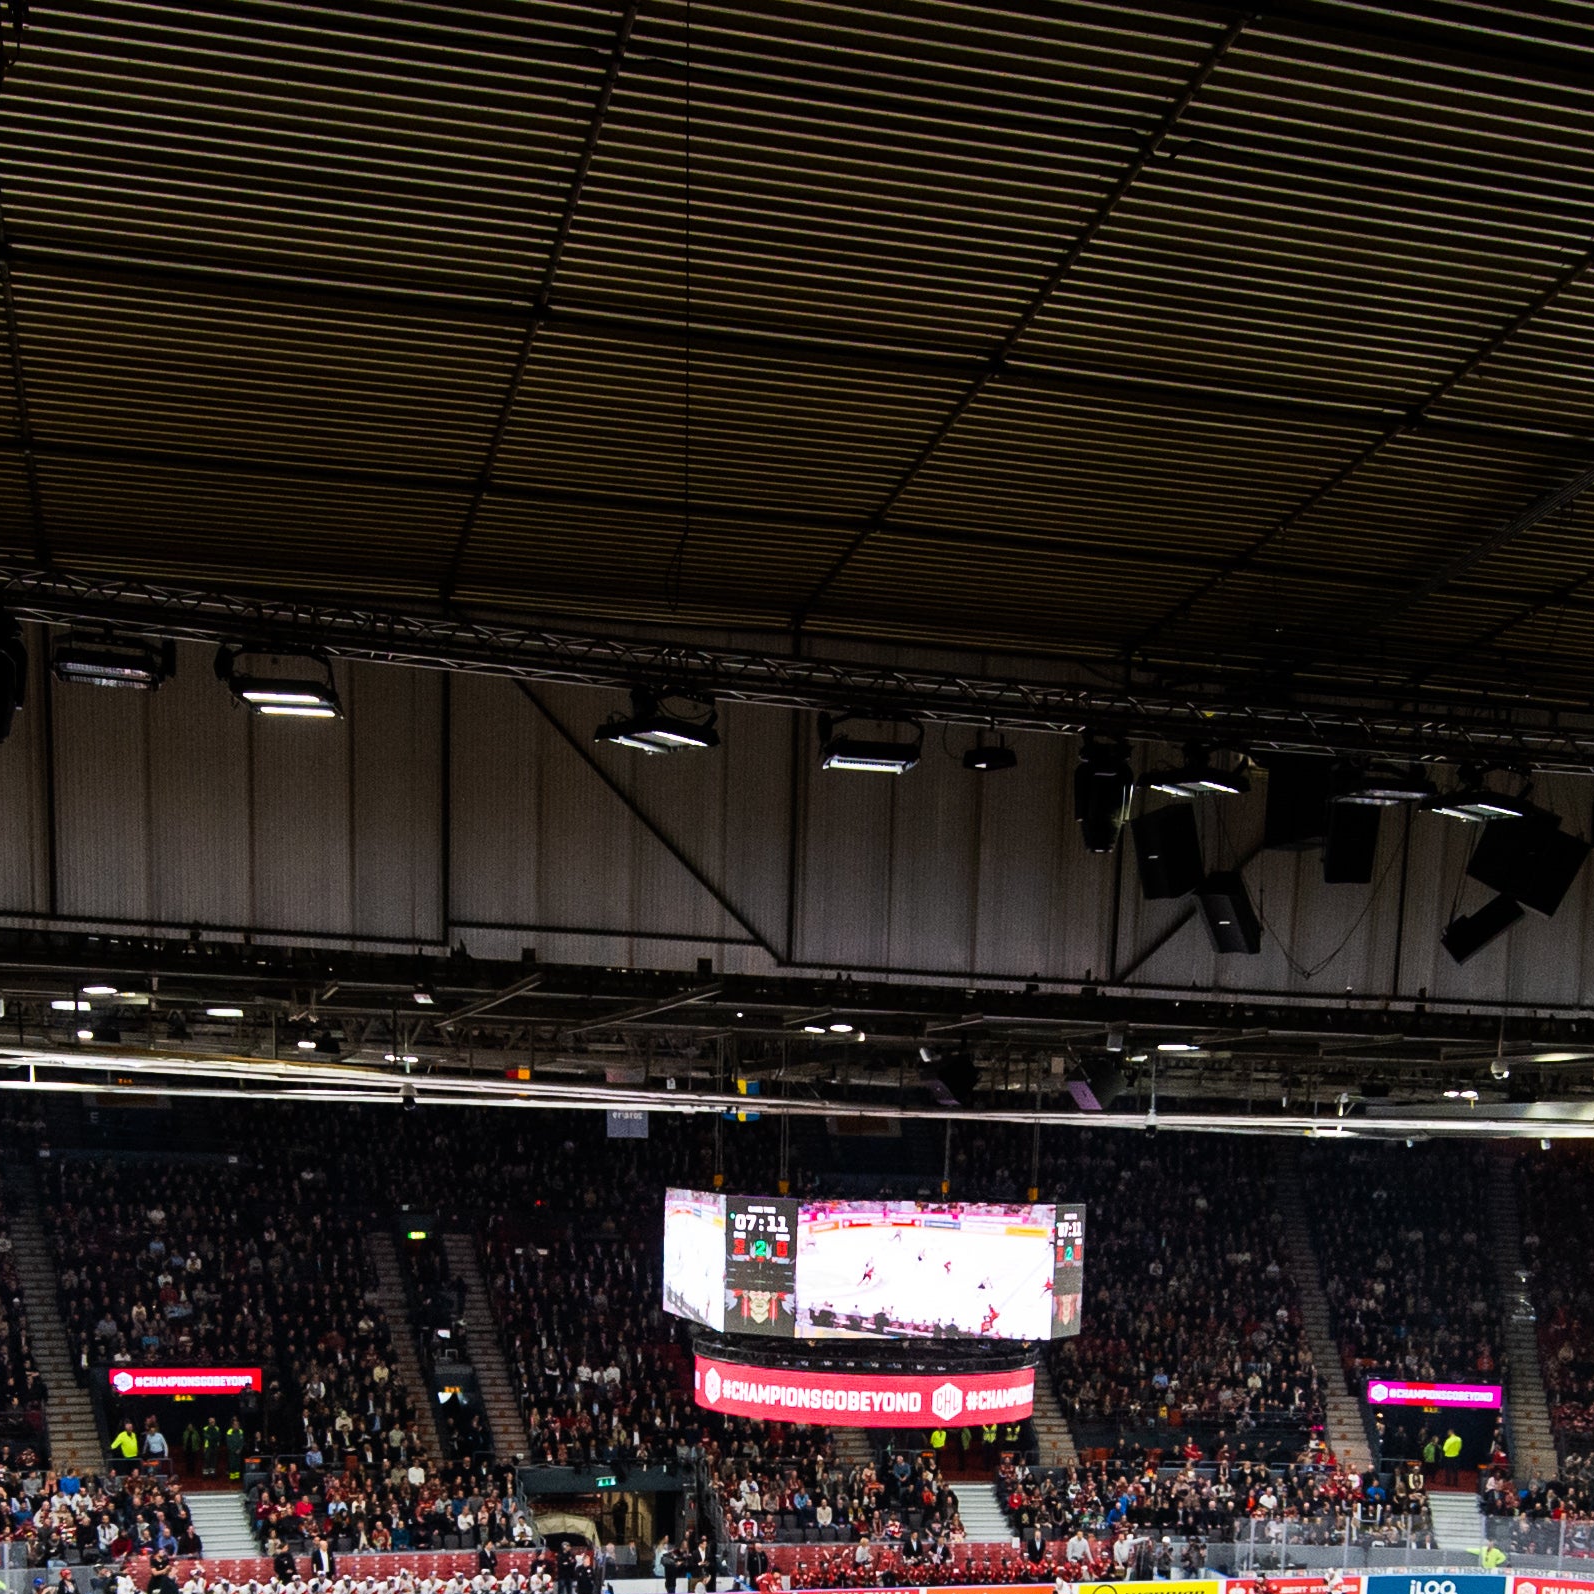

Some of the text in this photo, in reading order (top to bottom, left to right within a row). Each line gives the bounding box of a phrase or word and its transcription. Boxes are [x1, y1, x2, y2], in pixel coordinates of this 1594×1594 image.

[735, 1214, 788, 1232] 07:11
[755, 1240, 766, 1257] 2
[722, 1380, 922, 1413] #CHAMPIONSGOBEYOND
[1511, 1569, 1551, 1578] TISSOT
